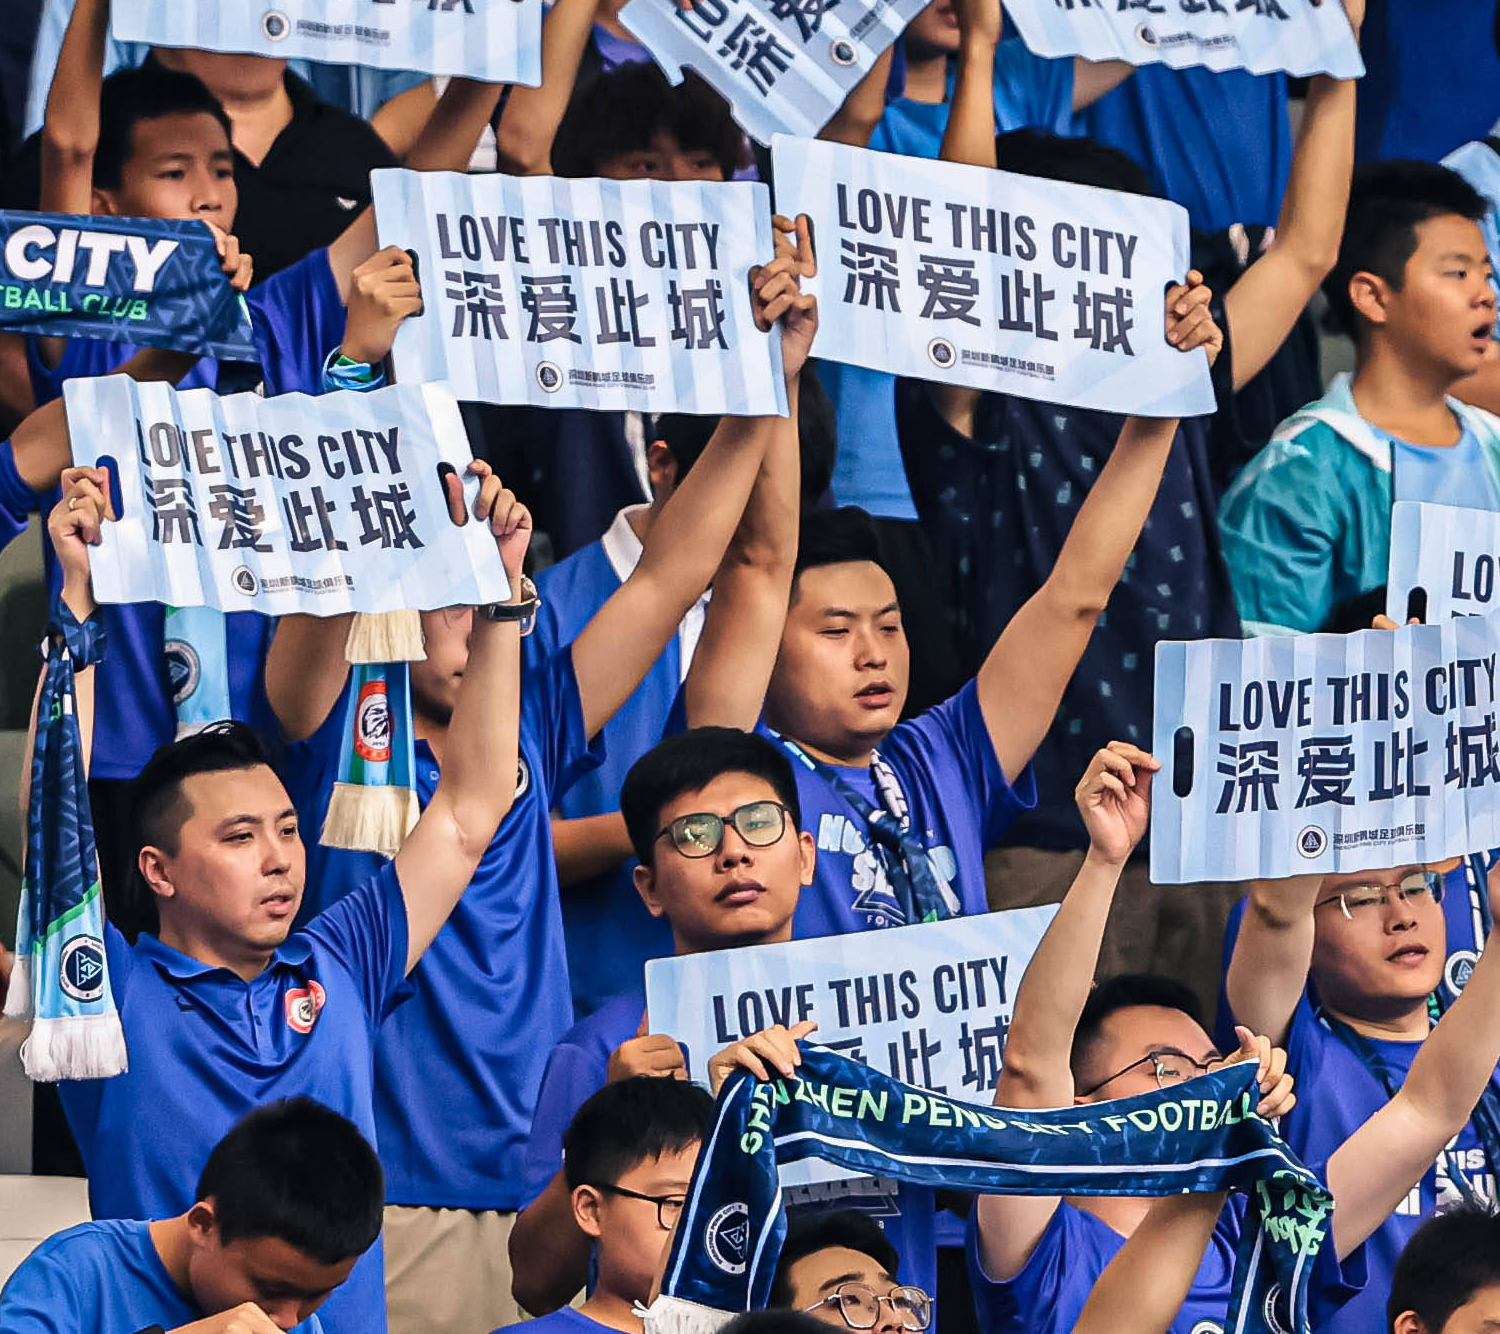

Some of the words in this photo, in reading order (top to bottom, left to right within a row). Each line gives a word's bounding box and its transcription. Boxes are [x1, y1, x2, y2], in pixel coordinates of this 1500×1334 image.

[4, 224, 180, 292] CITY
[436, 214, 530, 264] LOVE
[538, 218, 626, 268] THIS
[640, 221, 719, 270] CITY
[837, 183, 933, 243] LOVE
[945, 203, 1036, 261] THIS
[1052, 222, 1138, 279] CITY
[83, 293, 147, 320] CLUB
[445, 270, 729, 350] 深爱此城
[840, 238, 1136, 357] 深爱此城
[1219, 678, 1312, 731] LOVE
[1327, 670, 1409, 725] THIS
[1425, 653, 1496, 720] CITY
